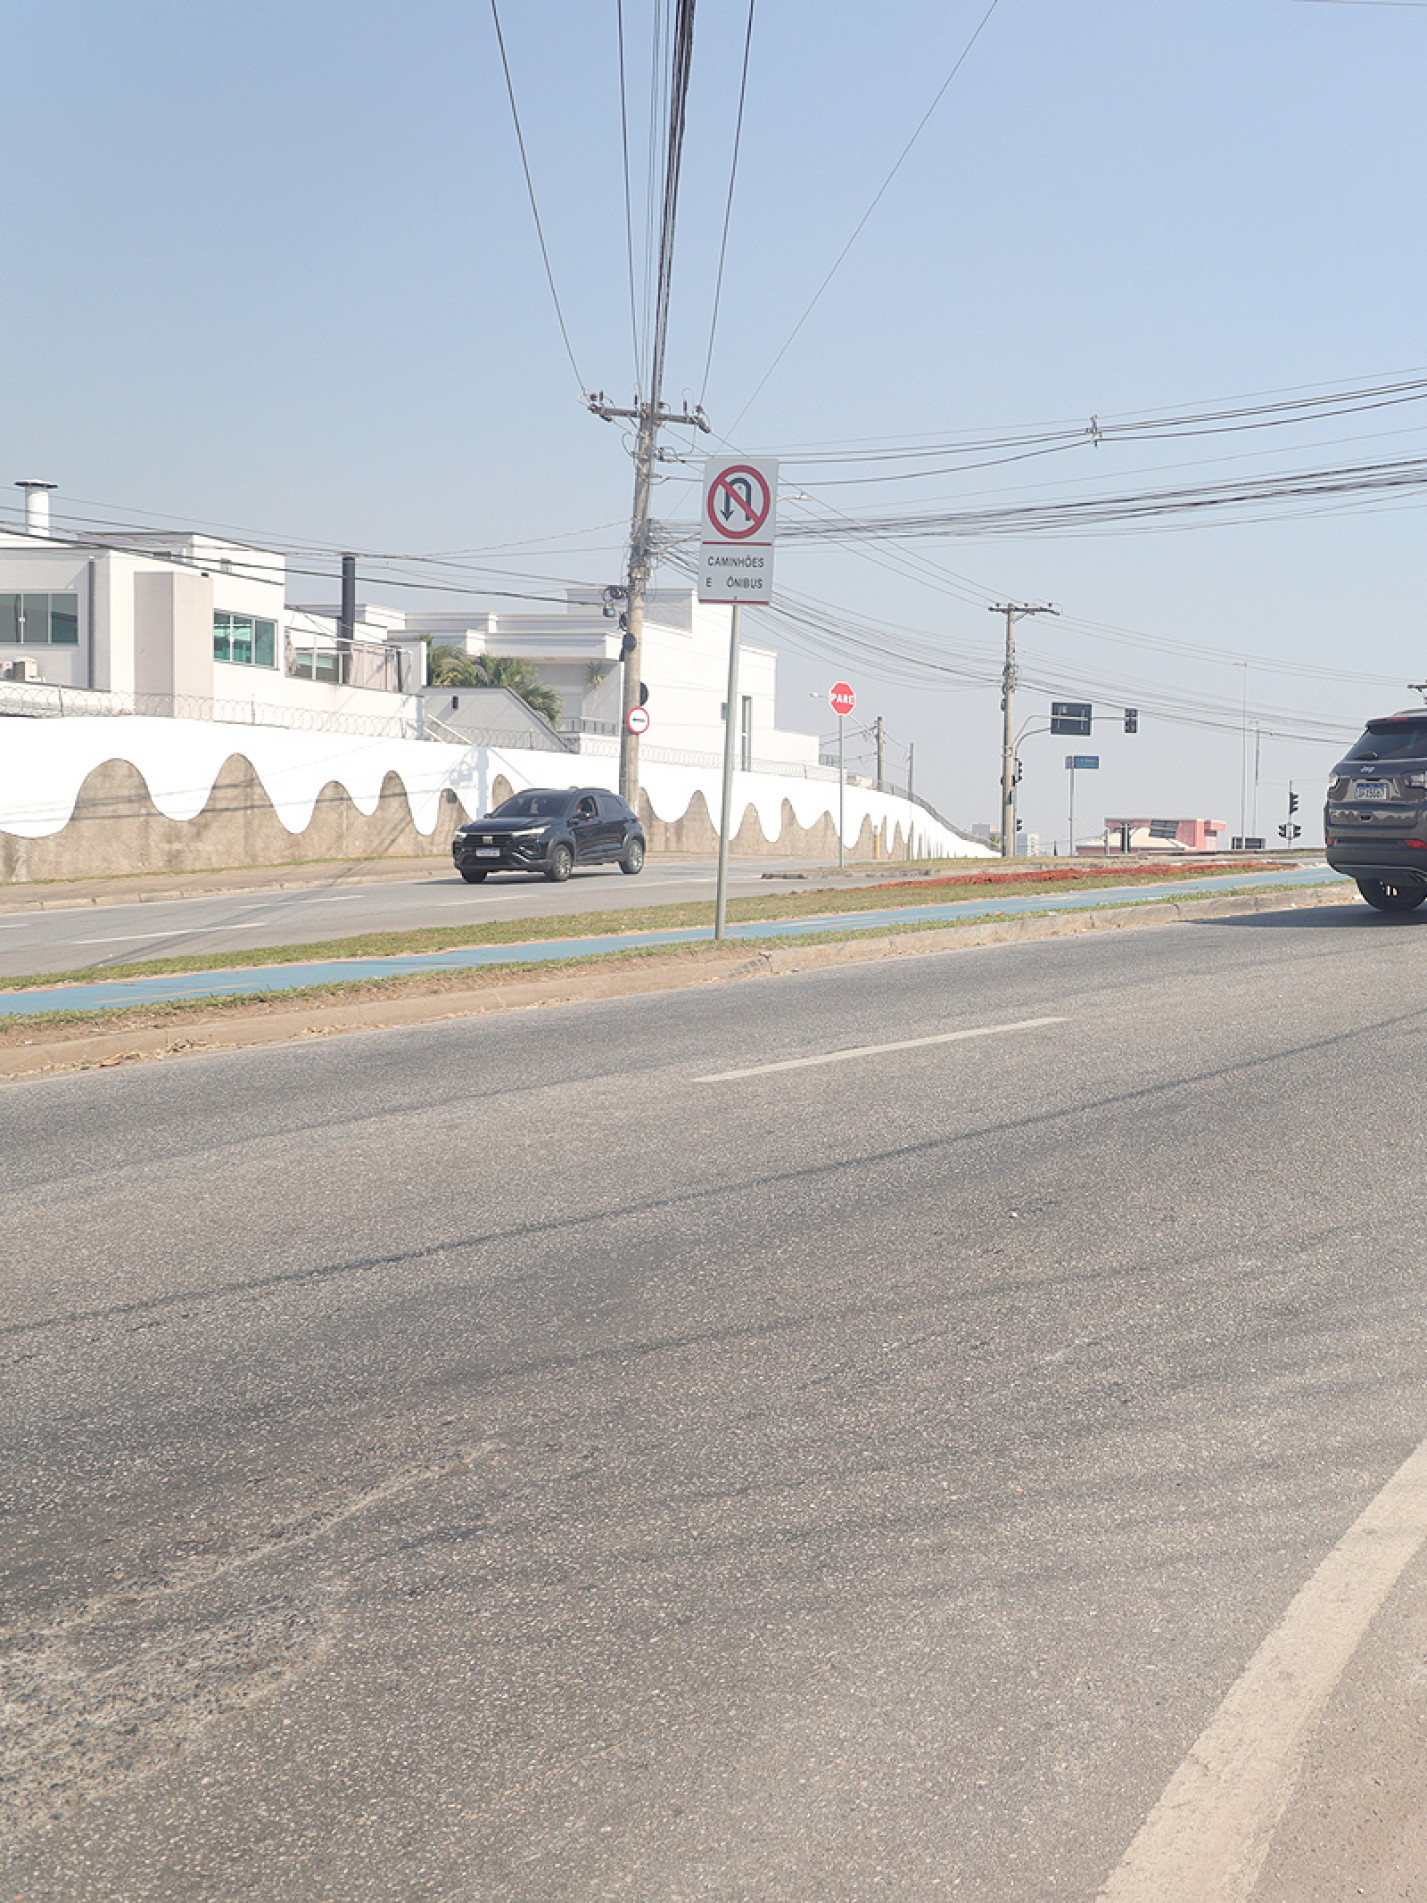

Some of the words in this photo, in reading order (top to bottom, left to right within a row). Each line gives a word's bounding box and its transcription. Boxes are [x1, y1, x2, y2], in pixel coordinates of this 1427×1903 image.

[708, 555, 764, 568] CAMINHÕES
[706, 577, 712, 587] E
[726, 575, 763, 589] ÔNIBUS
[830, 693, 854, 705] PARE
